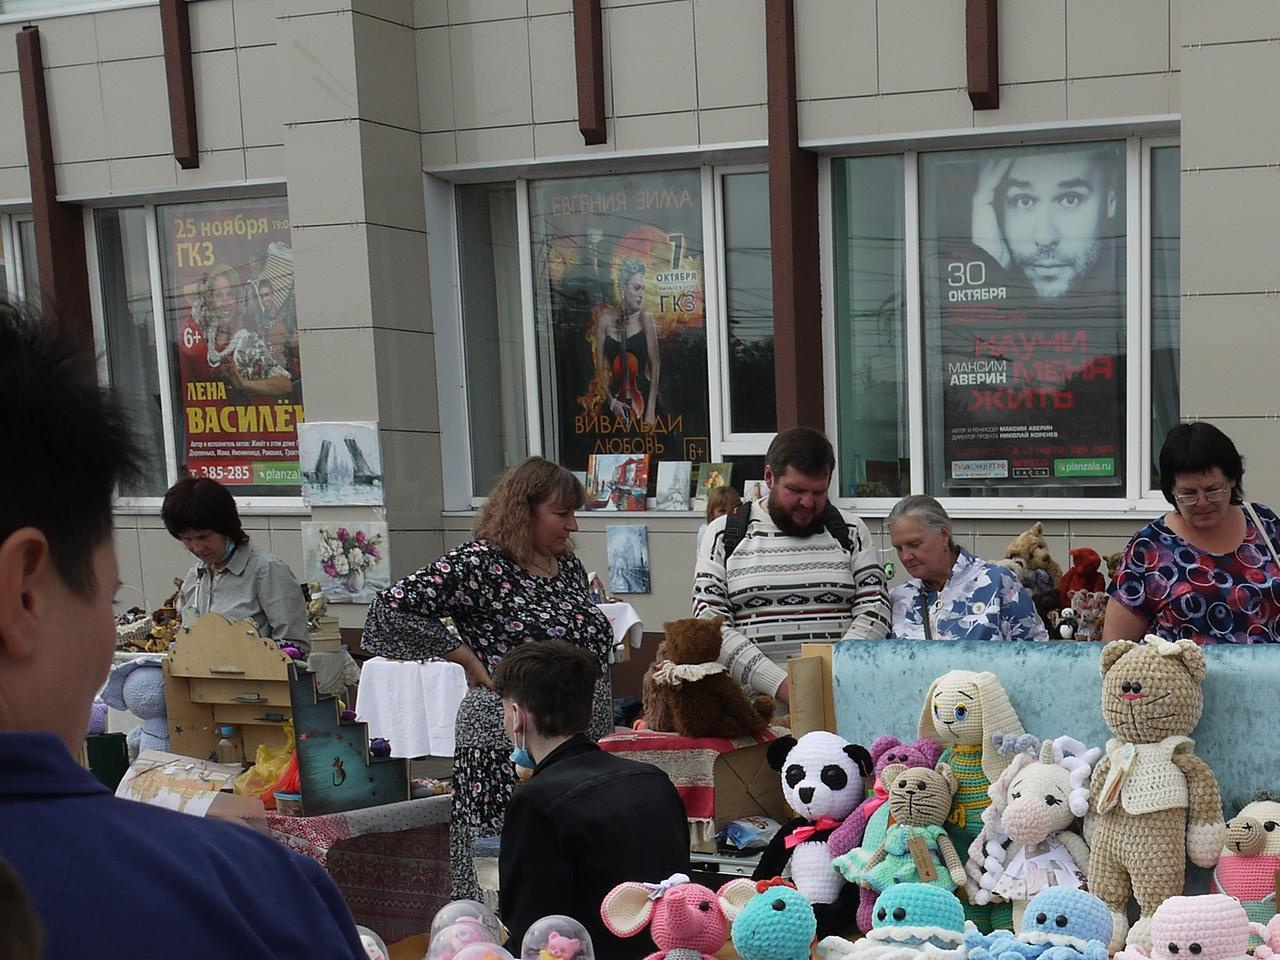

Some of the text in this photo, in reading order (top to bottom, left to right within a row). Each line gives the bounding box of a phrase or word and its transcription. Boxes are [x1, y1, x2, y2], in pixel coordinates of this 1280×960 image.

[552, 189, 693, 217] ЕВГЕНИЯ ЗИМА
[175, 213, 289, 240] 25 ноября 19:0
[176, 241, 215, 268] ГКЗ
[656, 271, 697, 283] ОКТЯБРЯ
[947, 261, 986, 287] 30
[659, 293, 696, 314] ГКЗ
[948, 287, 1007, 302] ОКТЯБРЯ
[184, 327, 201, 348] 6+
[973, 328, 1088, 361] НАУЧИ
[948, 360, 1007, 375] МАКСИМ
[1011, 355, 1114, 385] МЕНЯ
[949, 373, 1007, 387] АВЕРИН
[187, 381, 227, 401] ЛЕНА
[969, 386, 1074, 412] ЖИТЬ
[575, 413, 683, 436] ВИВАЛЬДИ
[593, 437, 665, 455] ЛЮБОВЬ
[689, 443, 704, 461] 6+
[201, 465, 250, 480] 385-285
[266, 468, 300, 481] planzal
[1066, 461, 1112, 472] planzala.ru
